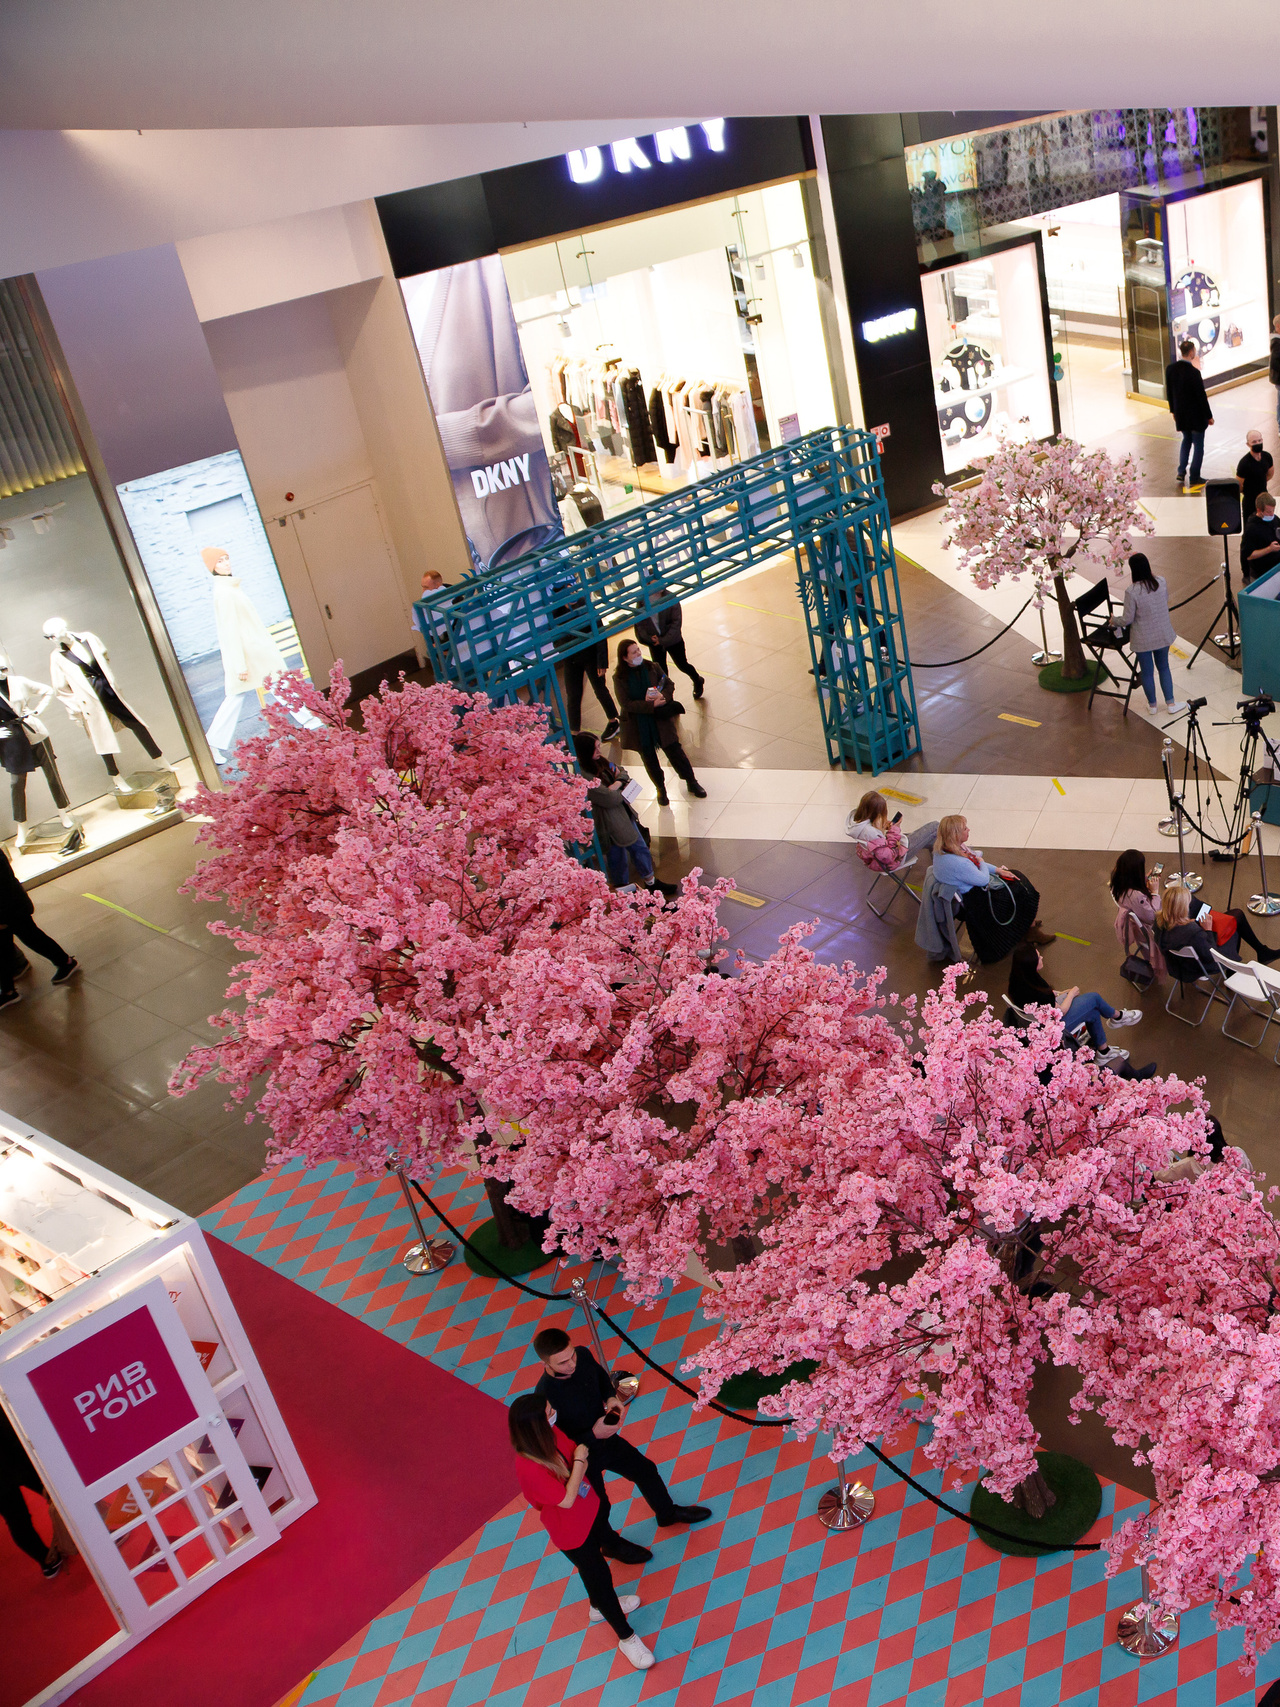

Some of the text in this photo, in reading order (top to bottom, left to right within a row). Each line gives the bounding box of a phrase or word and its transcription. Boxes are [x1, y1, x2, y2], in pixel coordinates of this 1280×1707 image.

[565, 117, 725, 184] DKNY
[470, 453, 531, 499] DKNY
[73, 1360, 147, 1415] РИВ
[82, 1378, 158, 1433] ГОШ
